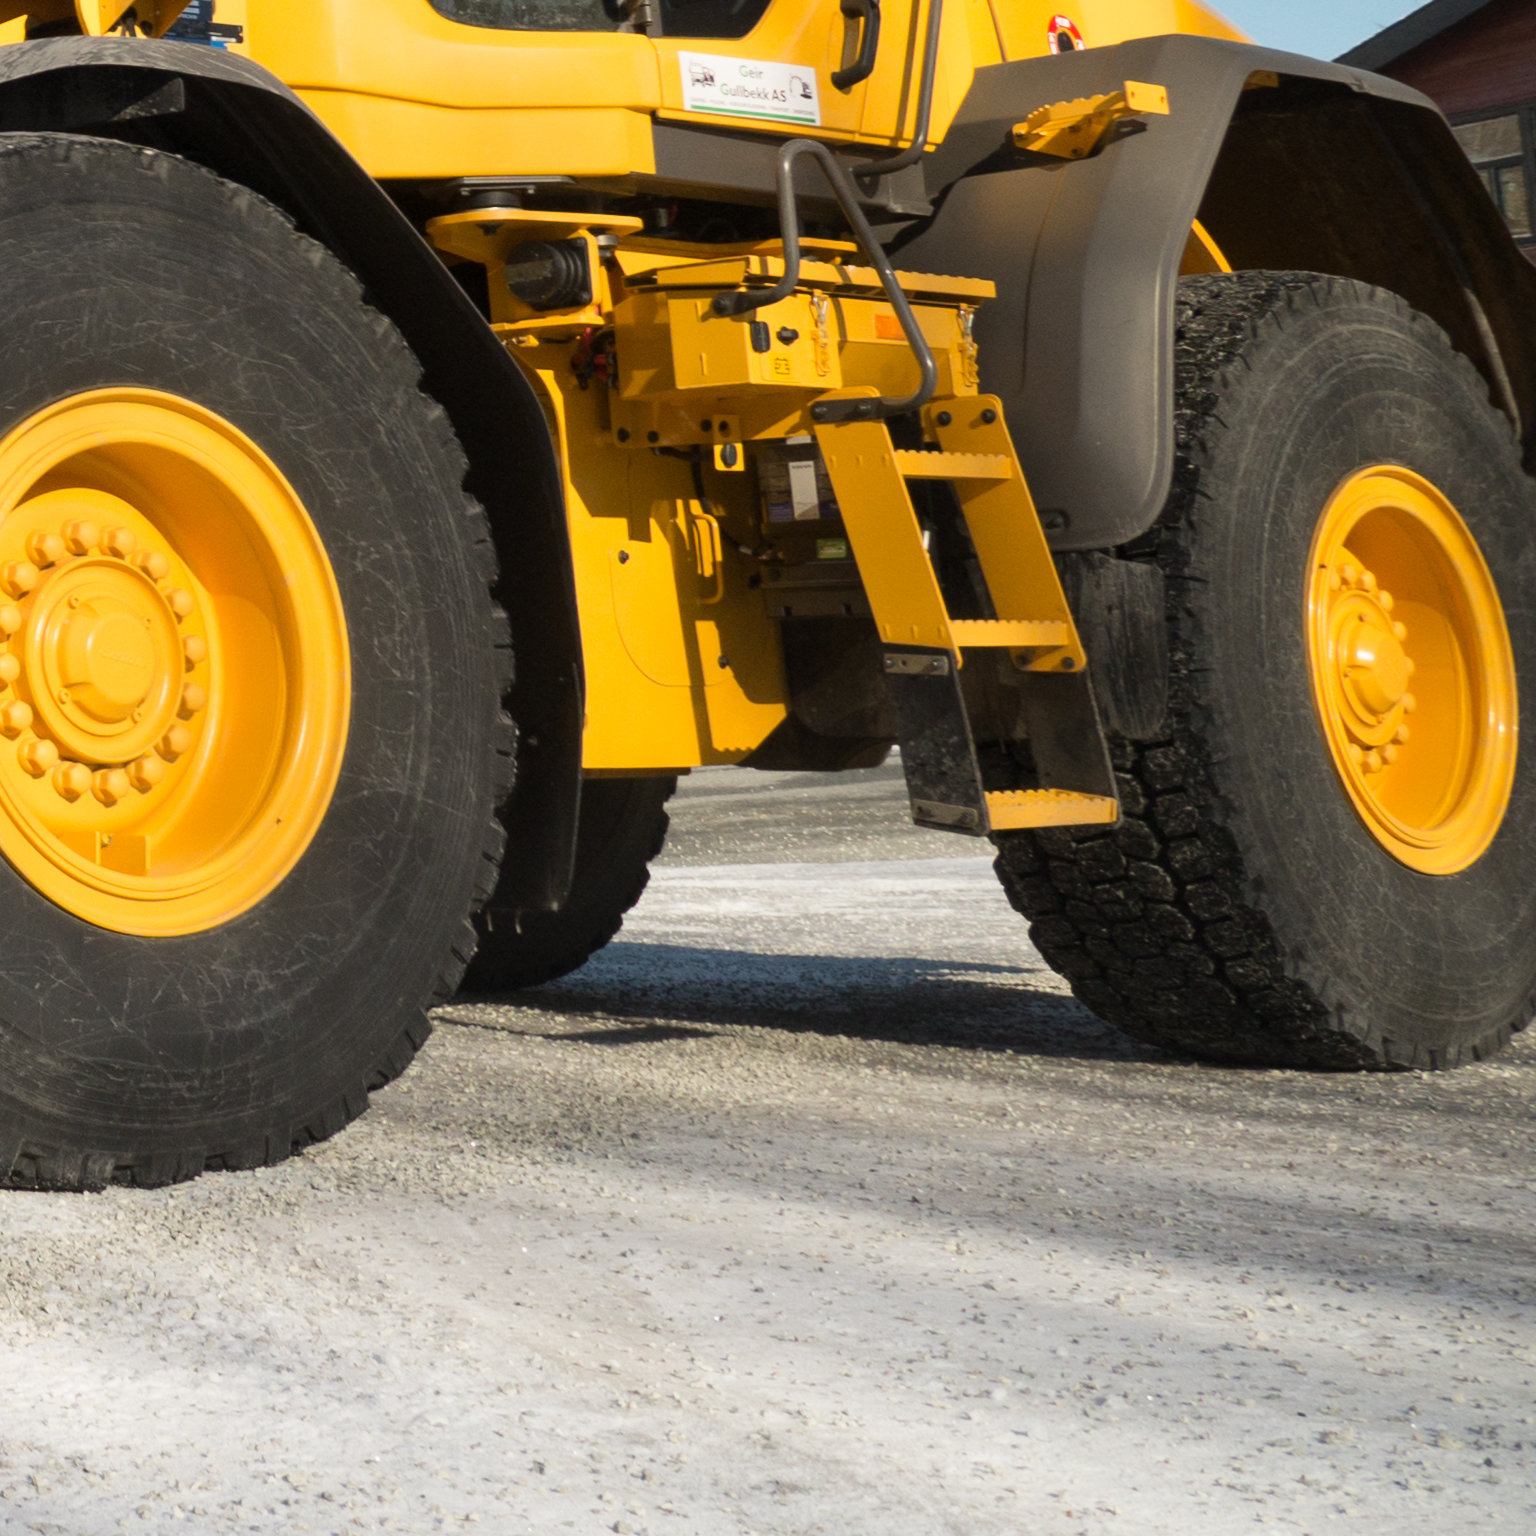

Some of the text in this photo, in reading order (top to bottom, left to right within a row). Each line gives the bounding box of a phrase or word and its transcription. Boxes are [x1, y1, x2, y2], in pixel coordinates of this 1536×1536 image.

[739, 65, 764, 79] Geir
[720, 83, 787, 102] Gullbekk AS
